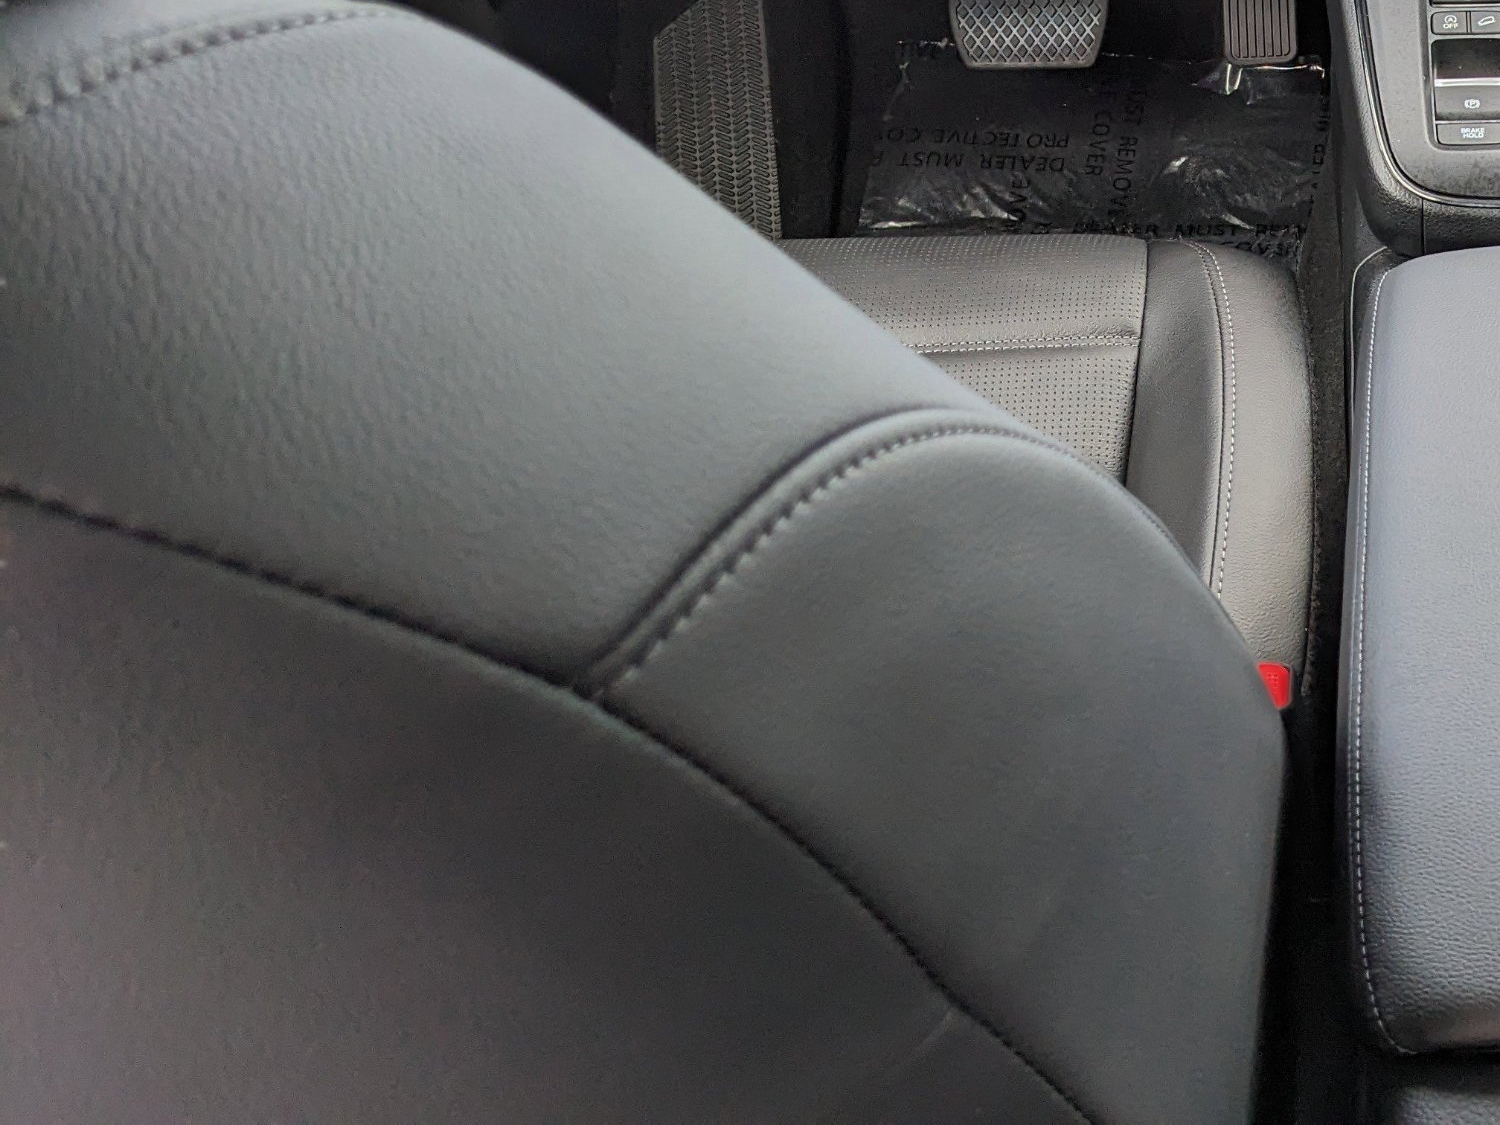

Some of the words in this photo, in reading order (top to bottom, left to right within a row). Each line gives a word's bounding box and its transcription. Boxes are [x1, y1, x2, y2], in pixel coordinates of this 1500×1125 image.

[933, 128, 1070, 149] PROTECTIVE
[896, 151, 964, 167] MUST
[980, 153, 1065, 173] DEALER
